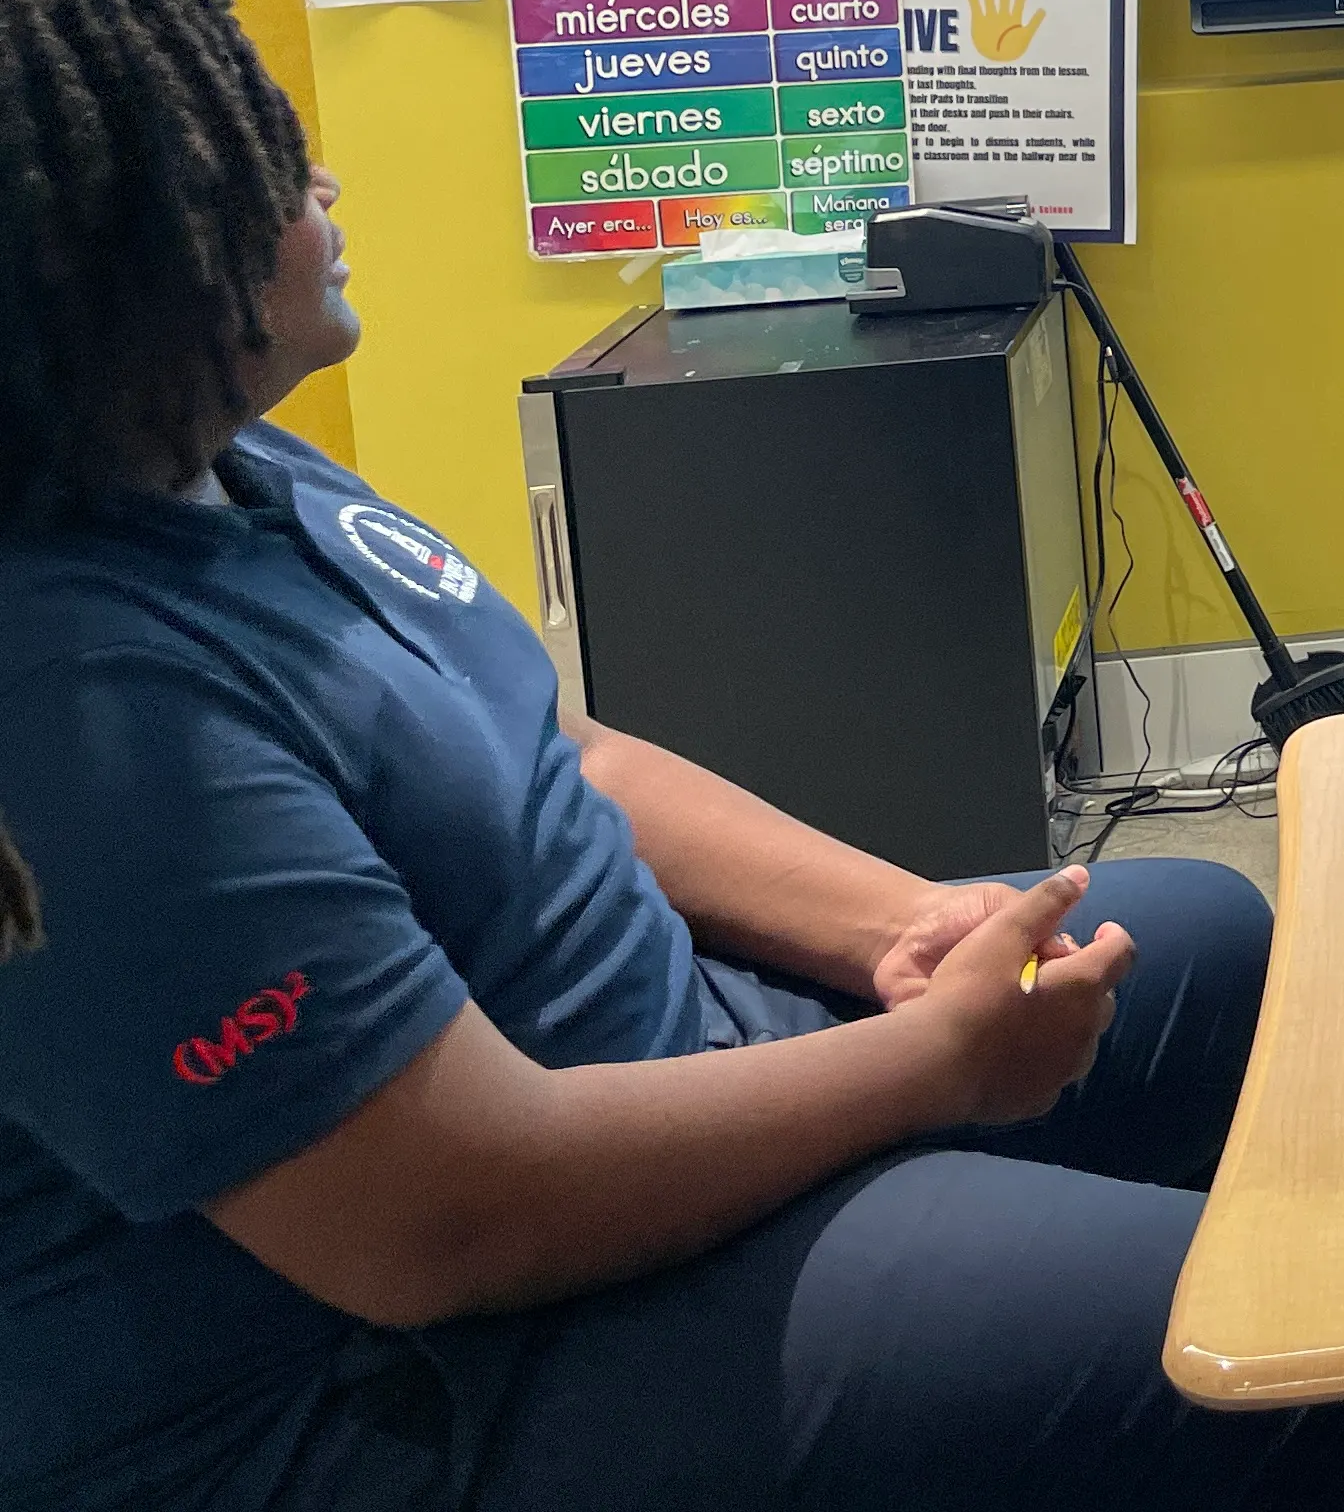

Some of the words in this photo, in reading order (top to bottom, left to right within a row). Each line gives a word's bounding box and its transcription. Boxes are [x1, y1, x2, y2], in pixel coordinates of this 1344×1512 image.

[905, 9, 959, 53] IVE
[574, 45, 712, 93] jueves
[797, 43, 890, 80] quinto
[578, 103, 723, 137] viernes
[807, 102, 885, 128] sexto
[580, 149, 729, 194] sábado
[790, 146, 905, 183] séptimo
[684, 208, 724, 232] Hoy
[729, 211, 769, 230] es...
[813, 192, 889, 213] Mañana
[548, 216, 597, 238] Ayer
[602, 216, 652, 234] era...
